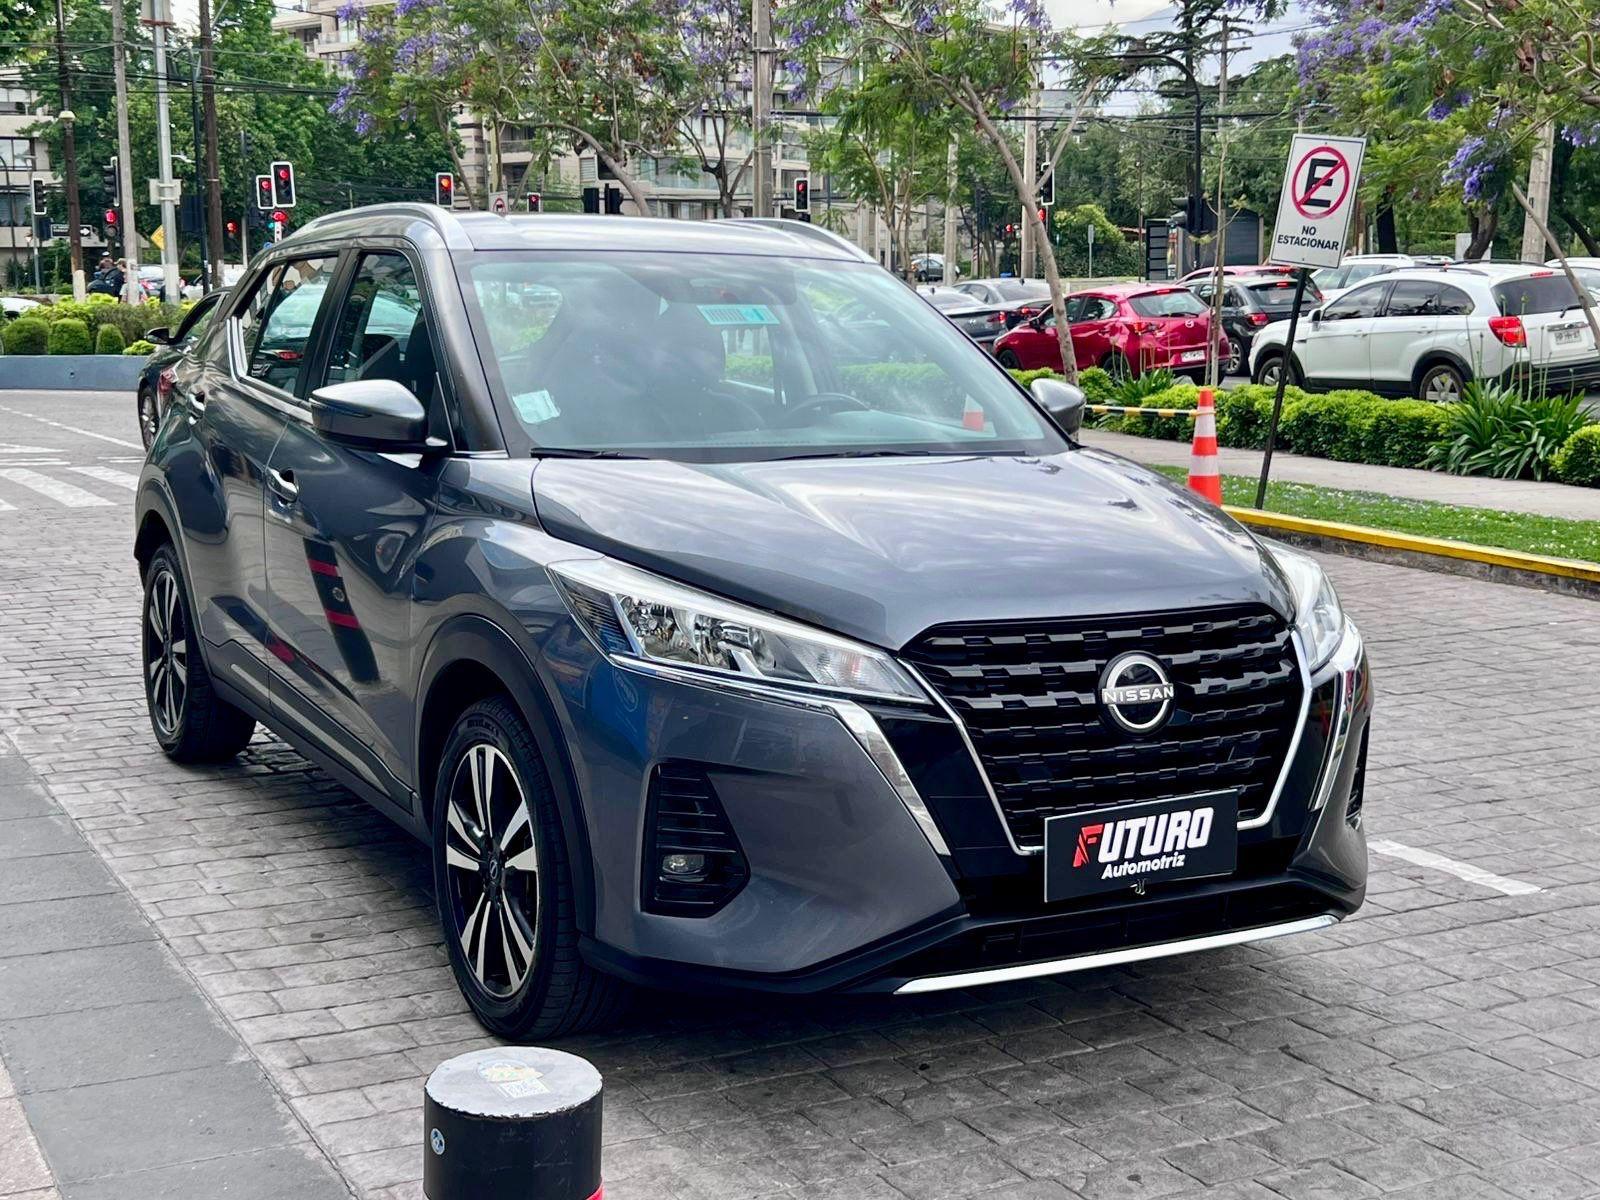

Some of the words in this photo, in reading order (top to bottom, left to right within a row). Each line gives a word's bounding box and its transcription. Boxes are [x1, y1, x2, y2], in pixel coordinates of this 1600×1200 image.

[1304, 158, 1338, 207] E
[1301, 225, 1317, 235] NO
[1277, 235, 1339, 250] ESTACIONAR
[1104, 686, 1174, 703] NISSAN
[1072, 807, 1214, 868] FUTURO
[1101, 853, 1185, 879] Automotriz
